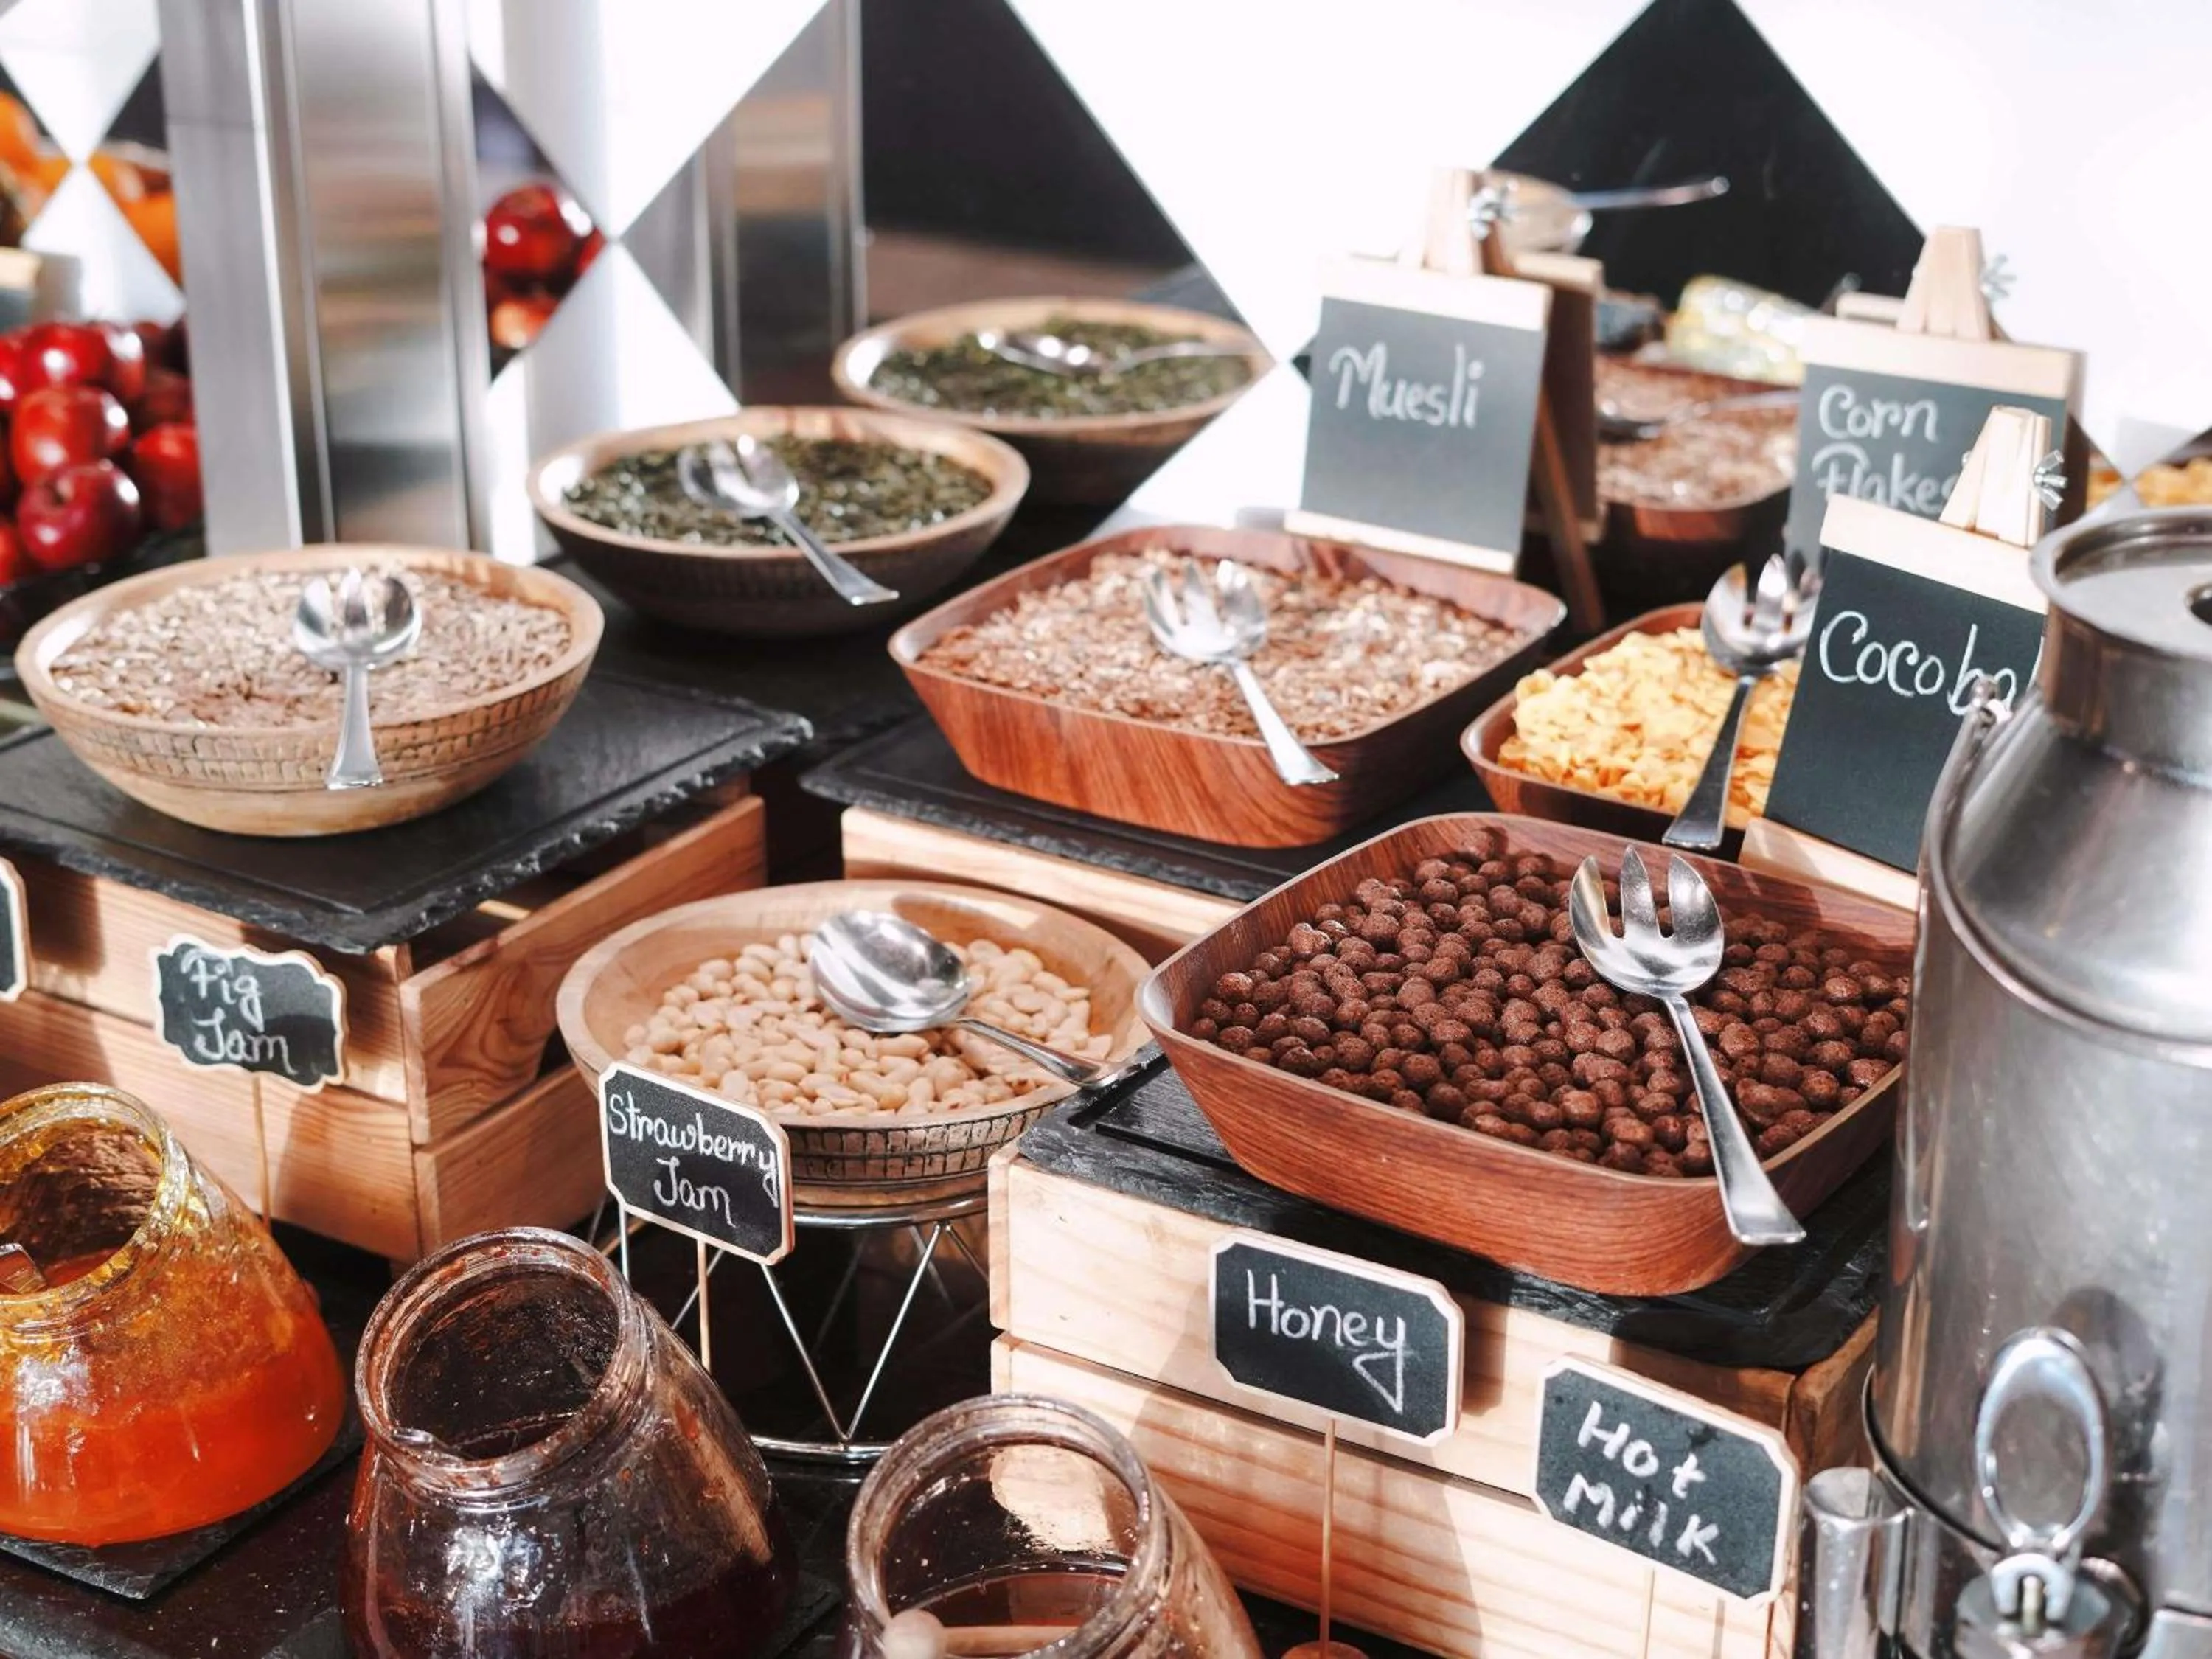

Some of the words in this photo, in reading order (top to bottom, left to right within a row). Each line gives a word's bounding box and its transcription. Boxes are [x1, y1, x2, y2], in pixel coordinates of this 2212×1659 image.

[1329, 341, 1485, 428] Muesli
[1818, 384, 1939, 442] Corn
[181, 947, 264, 1032] Fig
[192, 1007, 297, 1075] Jam
[608, 1091, 779, 1208] Strawberry
[654, 1155, 737, 1228] Jam
[1247, 1268, 1407, 1415] Honey
[1577, 1400, 1706, 1499] Hot
